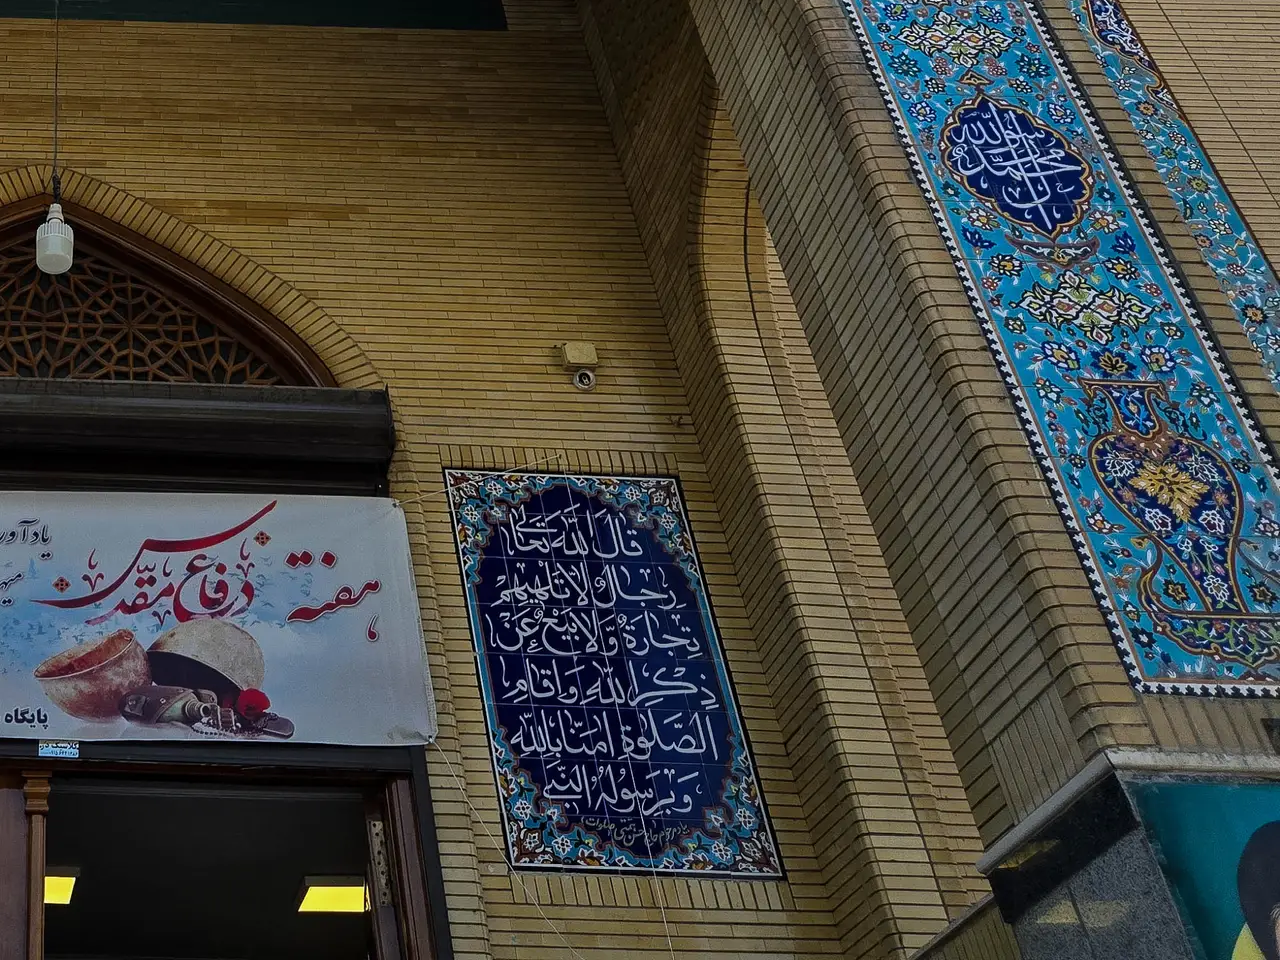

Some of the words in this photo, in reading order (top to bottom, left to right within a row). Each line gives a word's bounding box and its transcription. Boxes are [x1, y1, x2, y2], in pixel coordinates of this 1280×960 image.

[552, 509, 593, 555] الله
[593, 513, 643, 558] قال
[29, 499, 278, 626] مقدس
[172, 551, 255, 623] دفاع
[284, 548, 382, 630] هفته
[580, 660, 639, 706] الله
[4, 706, 49, 730] پایگاه
